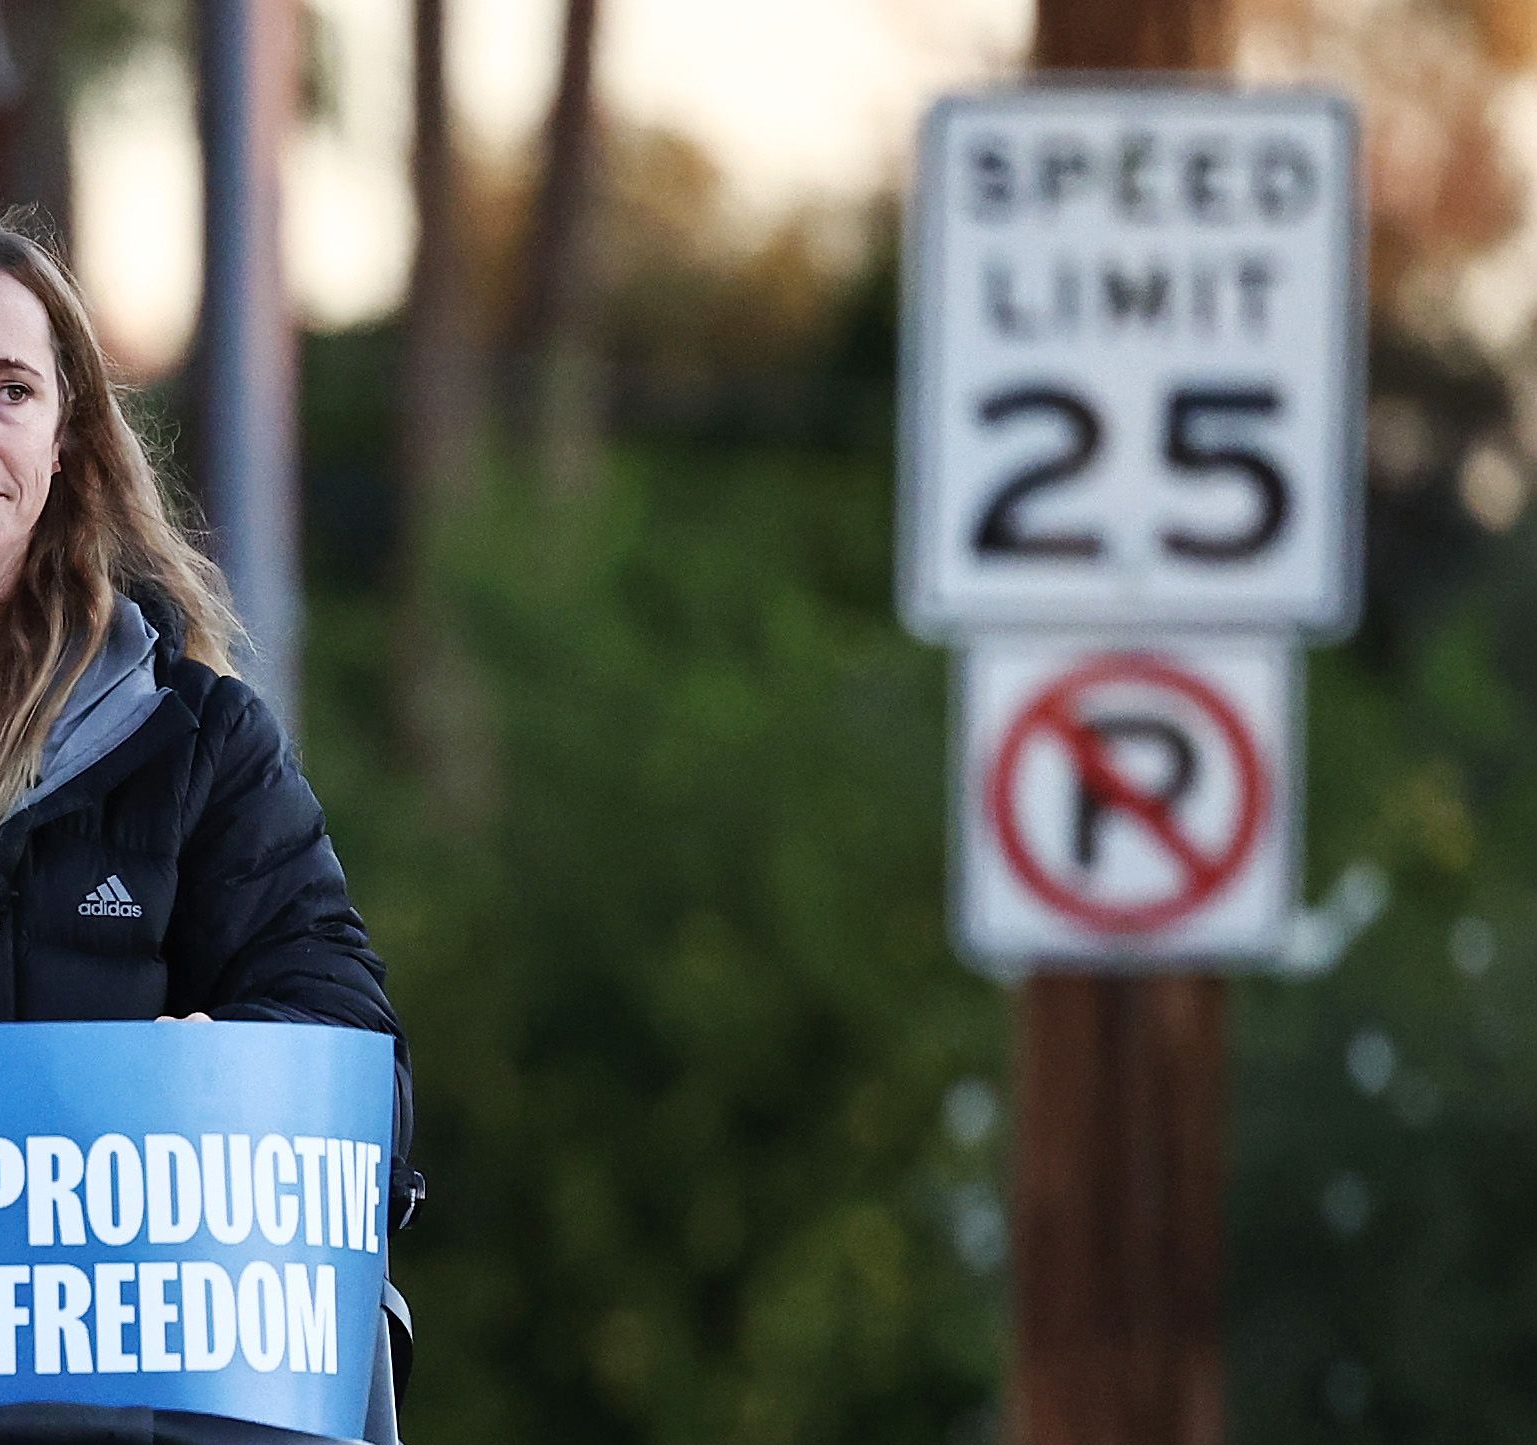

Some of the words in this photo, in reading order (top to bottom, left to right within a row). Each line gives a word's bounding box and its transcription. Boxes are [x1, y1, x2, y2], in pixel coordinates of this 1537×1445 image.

[965, 130, 1317, 222] SPEED
[981, 249, 1279, 341] LIMIT
[972, 384, 1292, 565] 25
[77, 900, 143, 918] adidas
